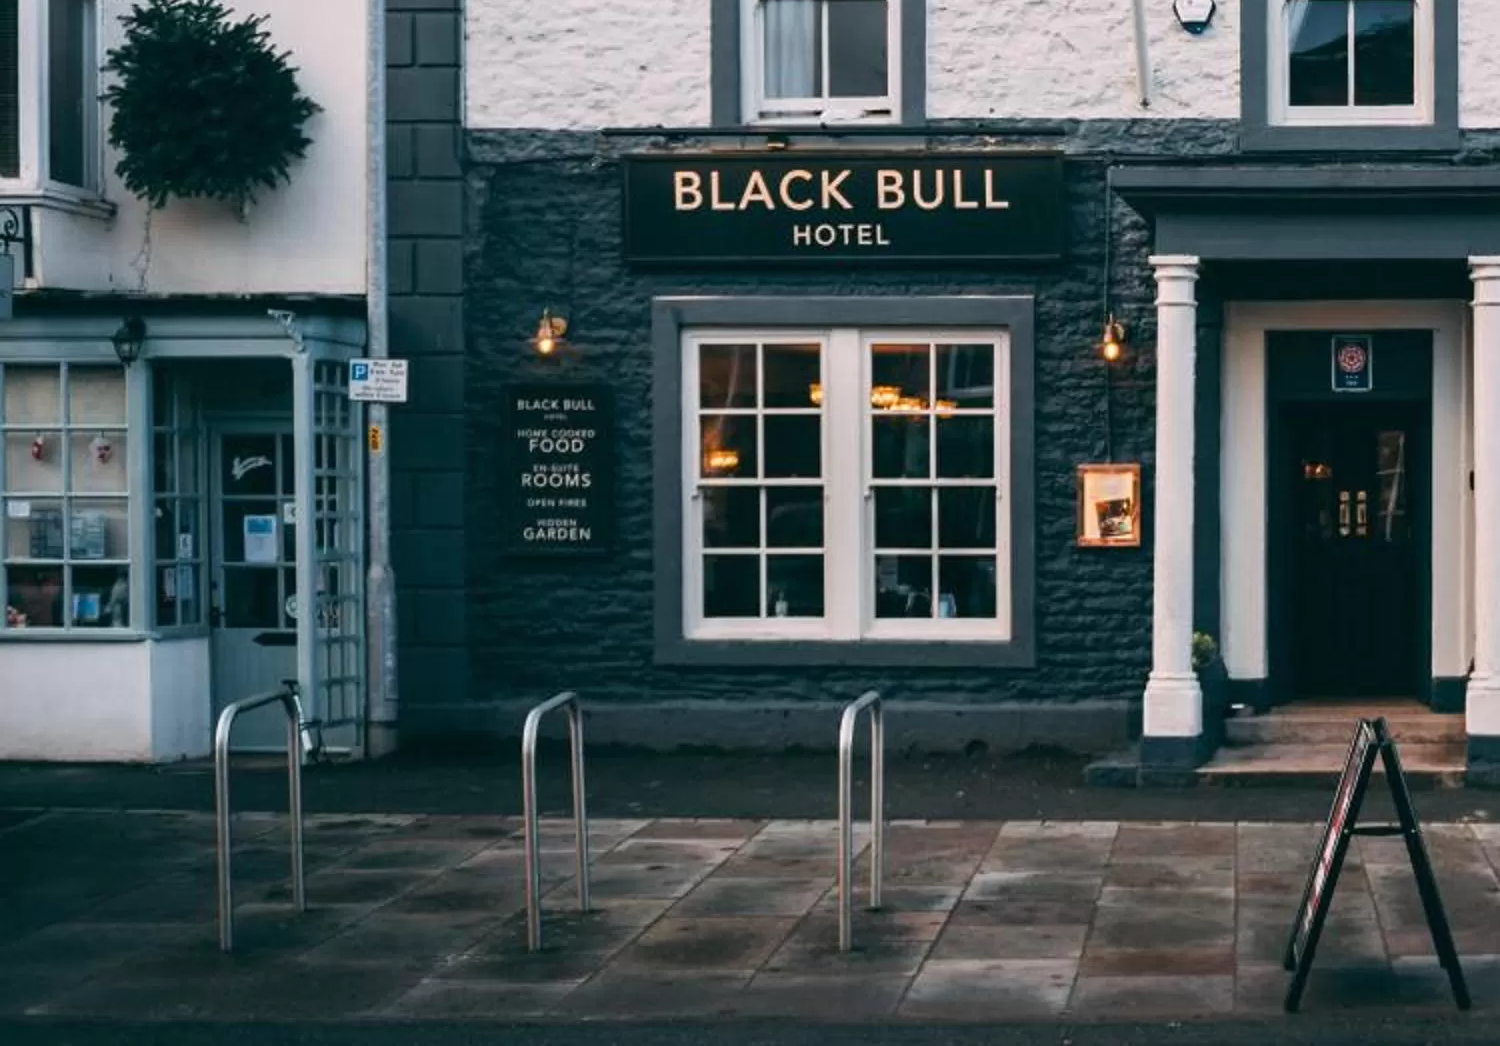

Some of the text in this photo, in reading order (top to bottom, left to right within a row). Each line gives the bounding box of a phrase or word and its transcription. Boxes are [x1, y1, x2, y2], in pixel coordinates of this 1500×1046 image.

[673, 169, 1009, 211] BLACK BULL
[793, 224, 890, 246] HOTEL
[355, 365, 366, 379] P
[517, 399, 595, 411] BLACK BULL
[517, 429, 596, 439] HOME COOKED
[529, 438, 584, 453] FOOD
[521, 473, 592, 487] ROOMS
[527, 498, 587, 507] OPEN FIRES
[537, 519, 577, 527] HIDDEN
[523, 527, 591, 540] GARDEN
